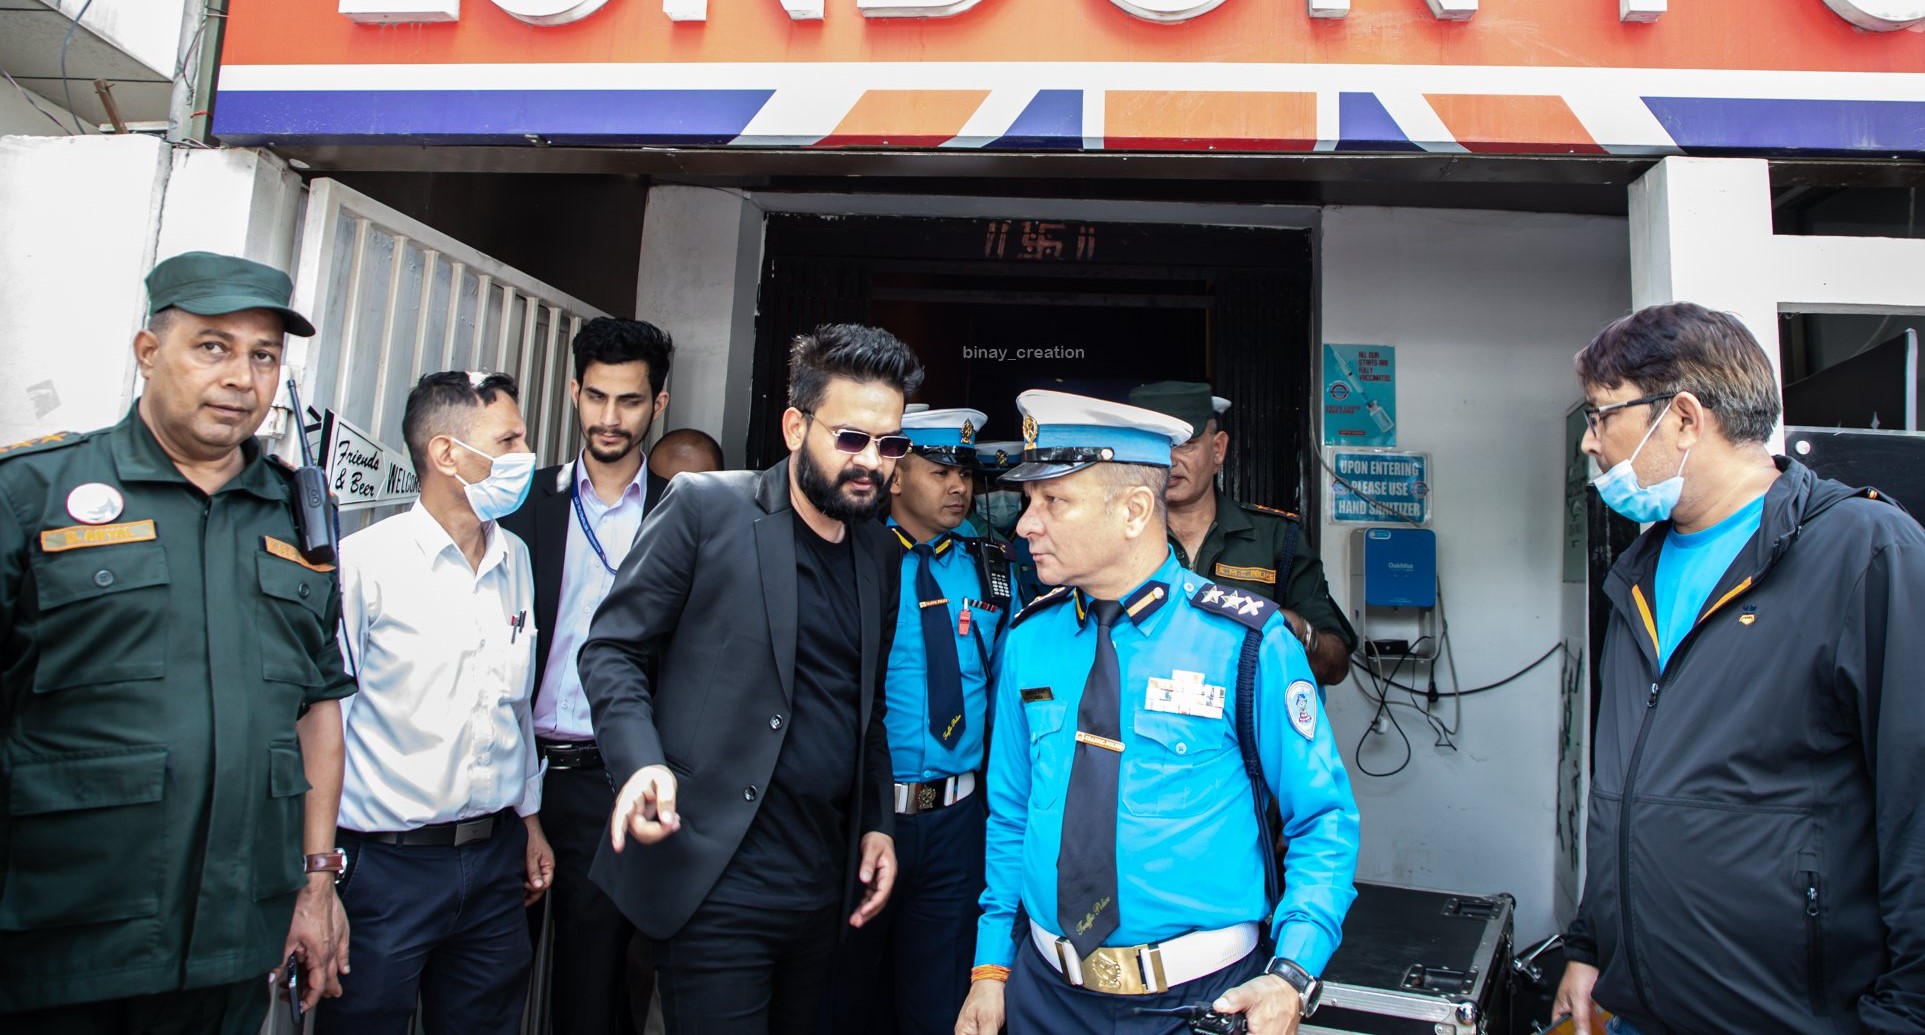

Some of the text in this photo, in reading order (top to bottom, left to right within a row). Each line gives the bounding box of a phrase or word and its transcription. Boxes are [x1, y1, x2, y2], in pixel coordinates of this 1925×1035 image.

[337, 440, 380, 471] Friends
[1340, 460, 1420, 476] UPON ENTERING
[335, 468, 375, 497] & Beer
[1351, 480, 1409, 496] PLEASE USE
[1338, 500, 1421, 517] HAND SANITIZER
[1250, 569, 1274, 581] POLICE
